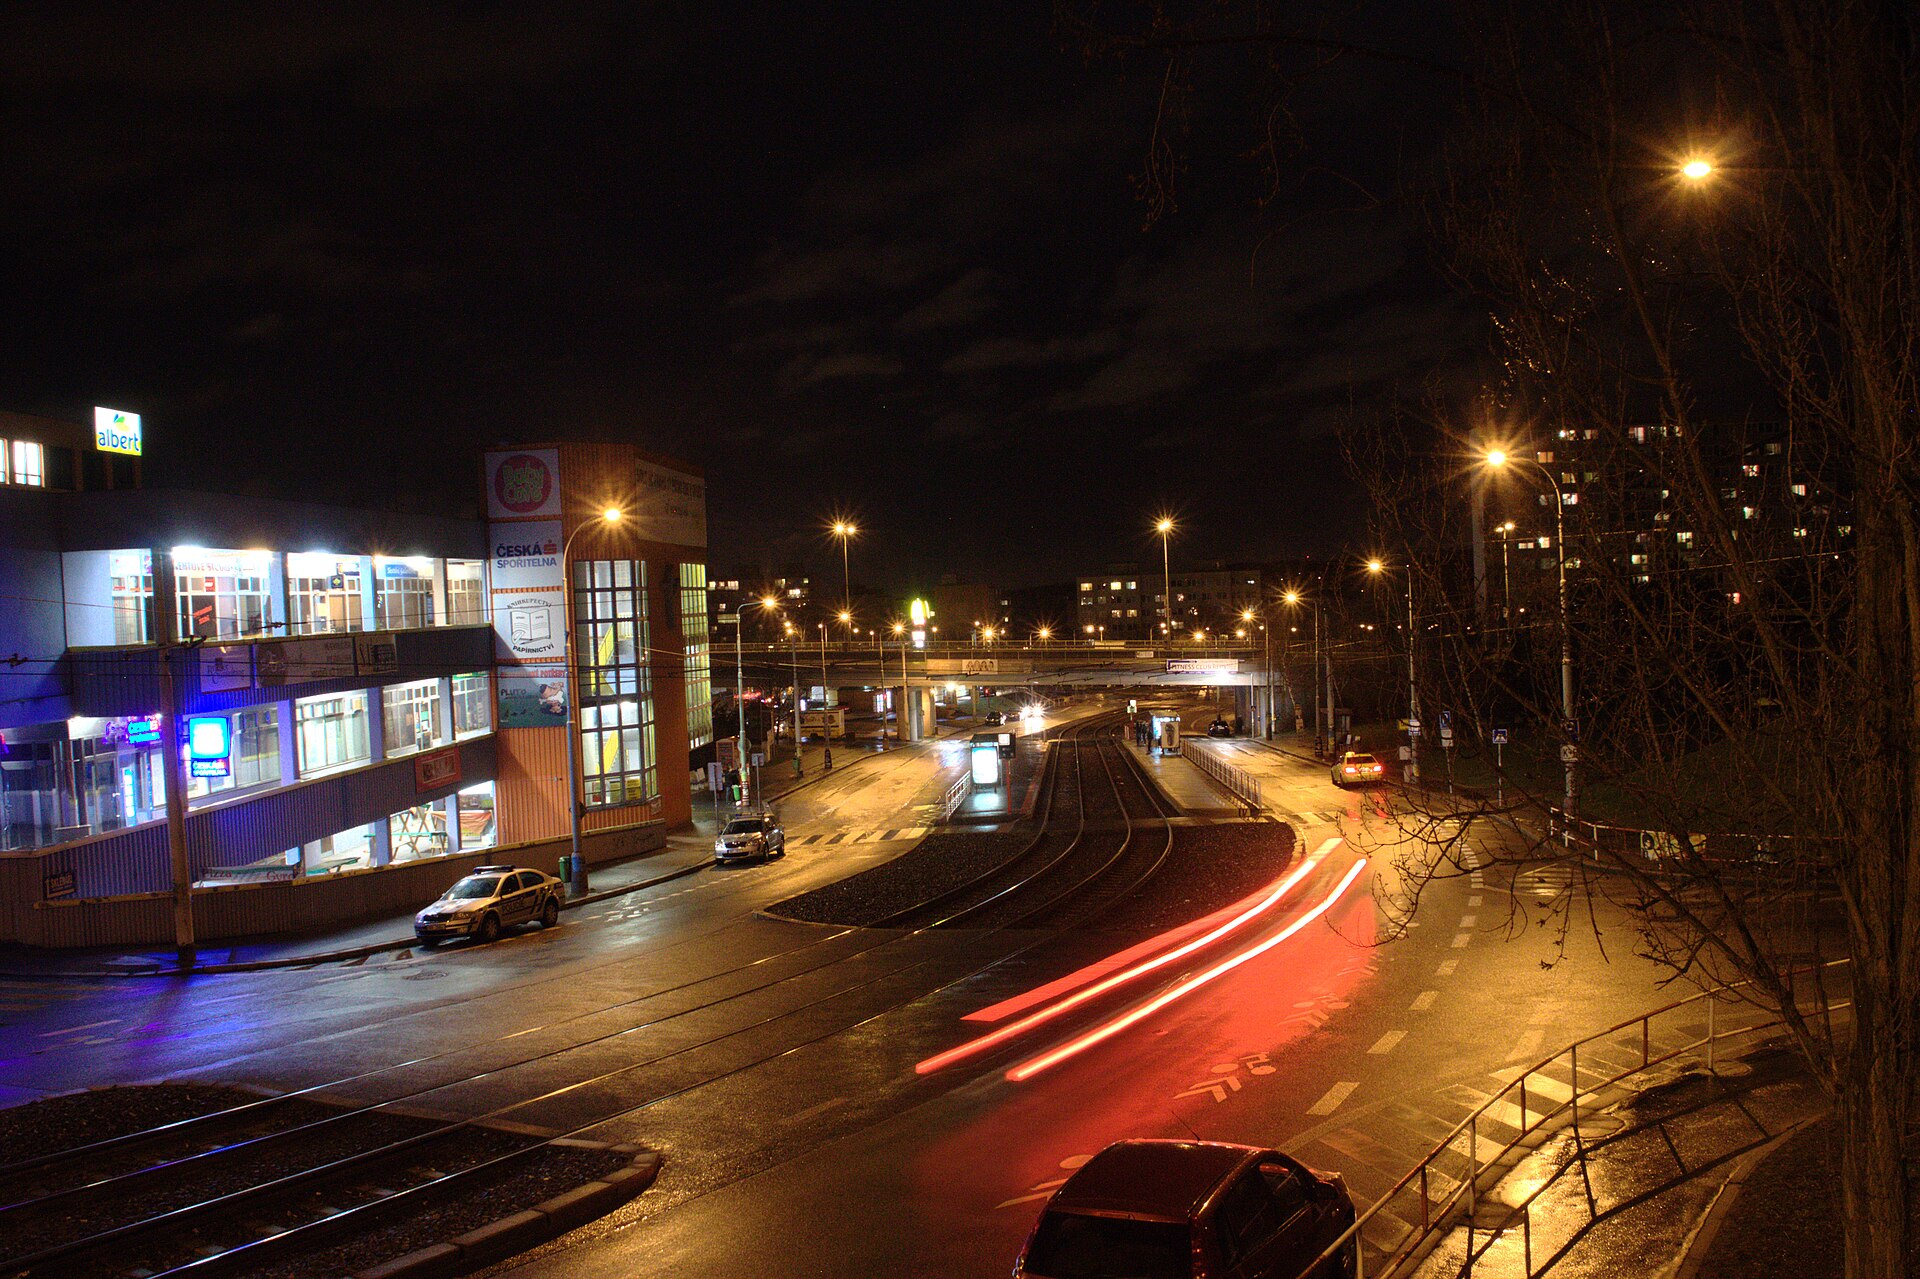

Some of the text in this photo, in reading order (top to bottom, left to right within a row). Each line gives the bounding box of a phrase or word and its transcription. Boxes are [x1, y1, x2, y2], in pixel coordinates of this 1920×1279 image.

[98, 429, 139, 451] albert
[496, 542, 542, 557] ČESKÁ
[497, 557, 557, 568] SPOŘITELNA
[512, 643, 555, 653] PAPÍRNICTVÍ
